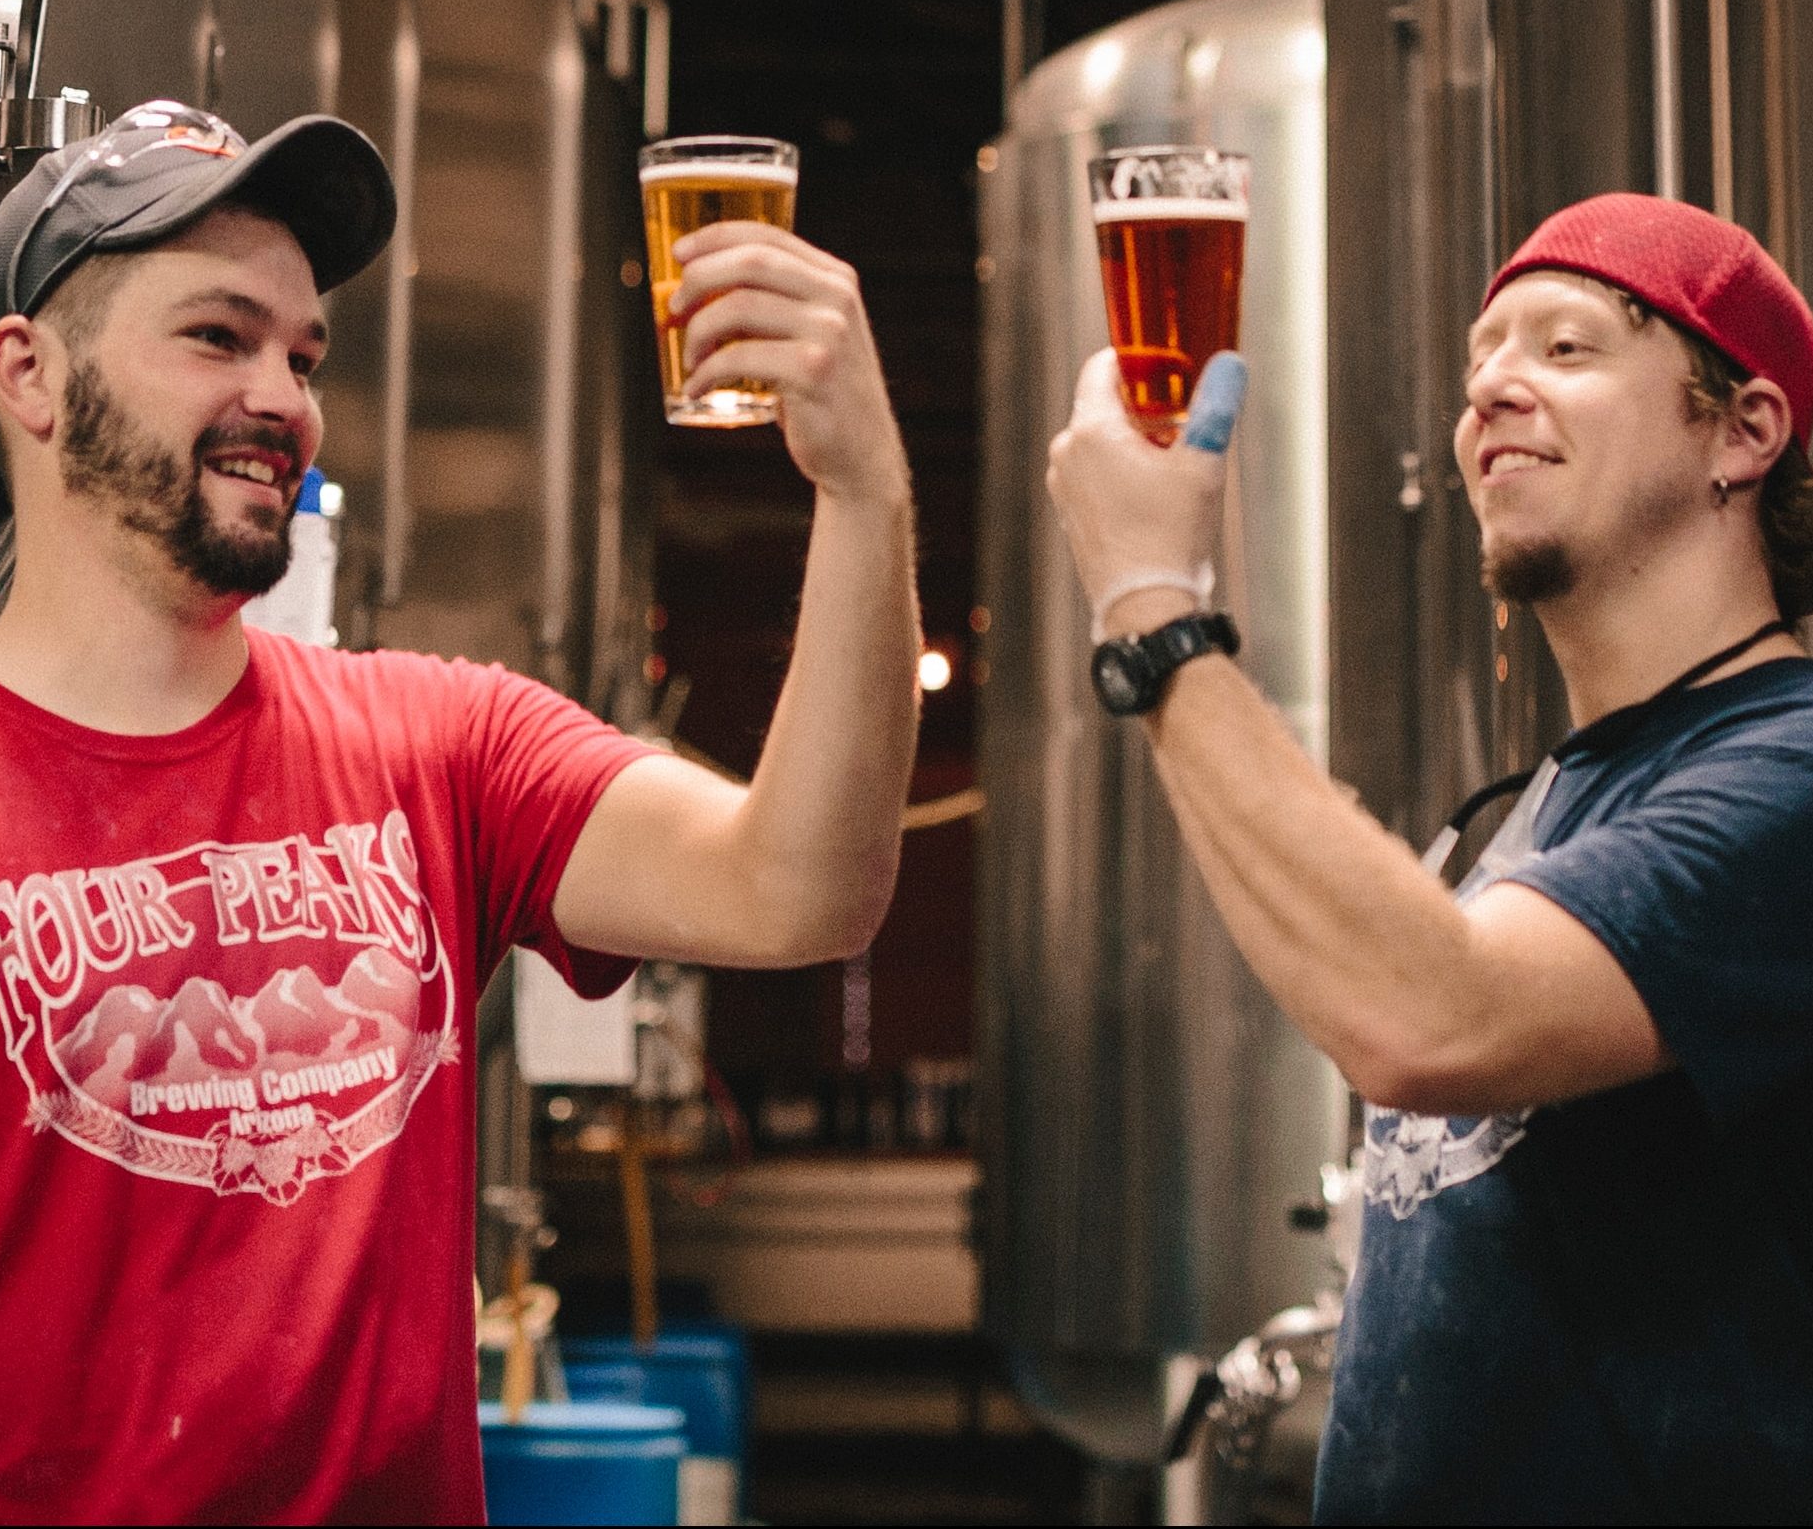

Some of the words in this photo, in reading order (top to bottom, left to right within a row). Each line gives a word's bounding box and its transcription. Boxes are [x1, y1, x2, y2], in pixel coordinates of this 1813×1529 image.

[130, 1074, 257, 1117] Brewing
[261, 1046, 397, 1105] Company
[229, 1102, 316, 1136] Arizona
